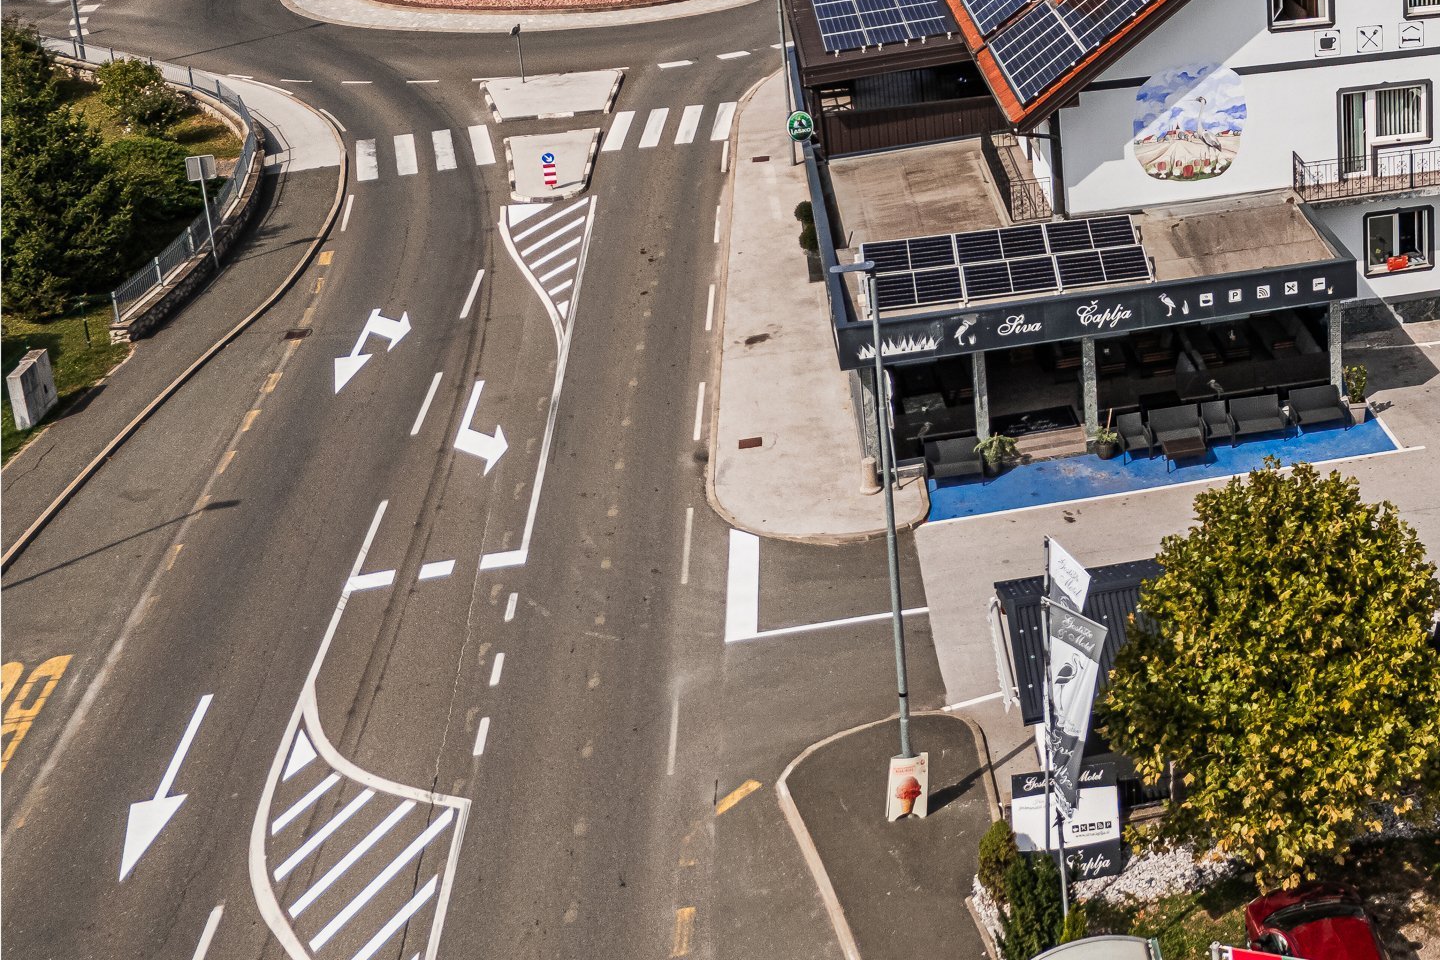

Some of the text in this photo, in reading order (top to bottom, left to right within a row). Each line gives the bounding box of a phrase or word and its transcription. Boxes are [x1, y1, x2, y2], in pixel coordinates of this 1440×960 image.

[997, 299, 1132, 336] Siva Čaplja
[1079, 769, 1104, 782] Motel
